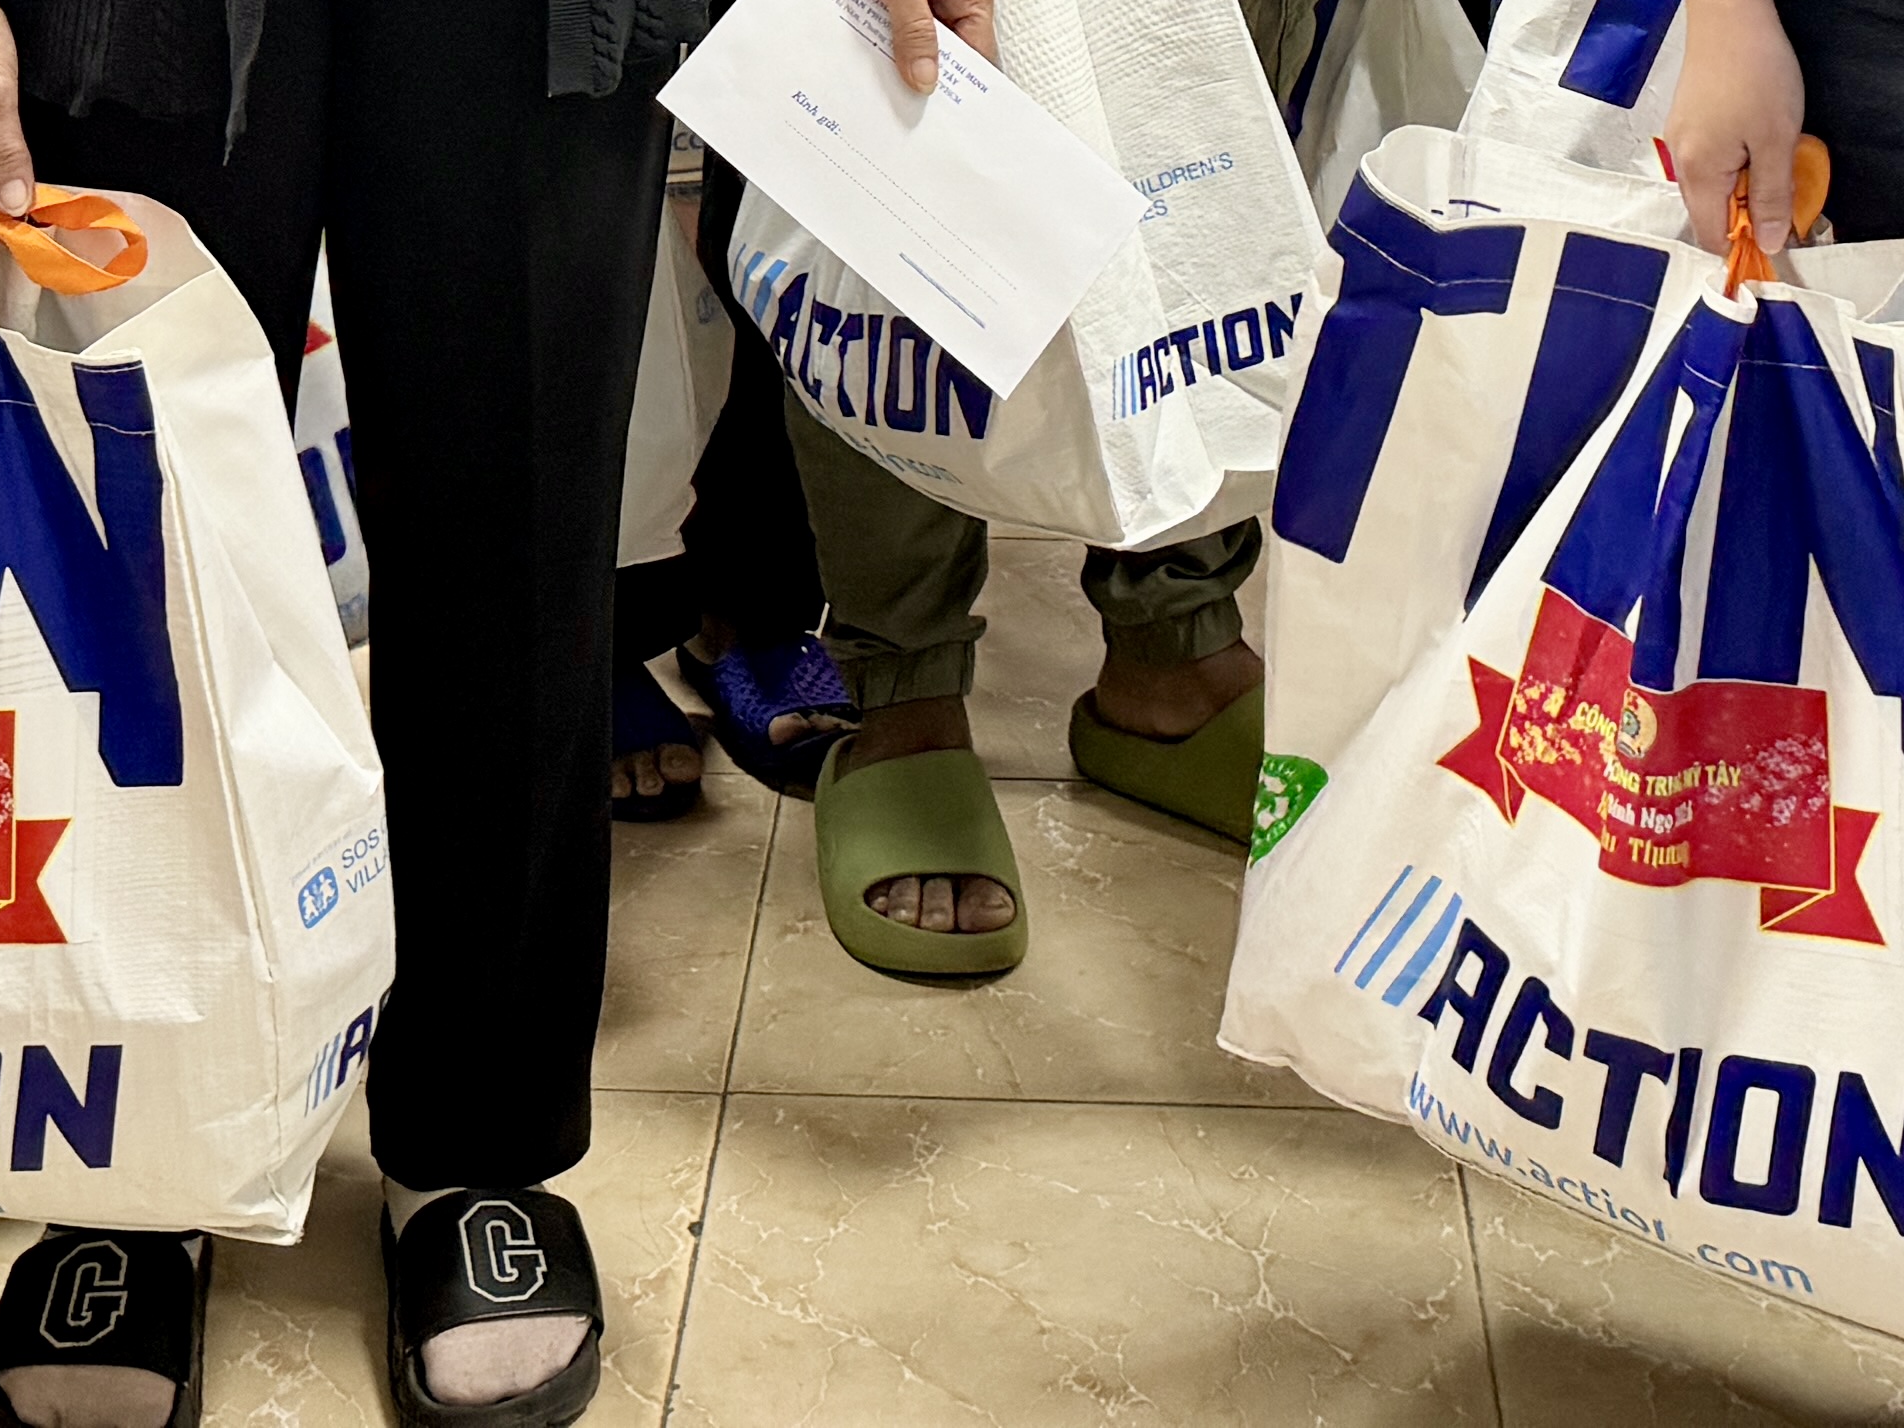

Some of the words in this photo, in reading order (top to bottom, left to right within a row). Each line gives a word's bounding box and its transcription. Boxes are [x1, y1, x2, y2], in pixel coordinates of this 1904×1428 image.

[1138, 292, 1303, 411] ACTION
[1704, 758, 1742, 788] TÂY
[342, 828, 382, 870] SOS
[1640, 807, 1674, 835] Ngọ
[458, 1199, 548, 1303] G
[39, 1238, 128, 1349] G
